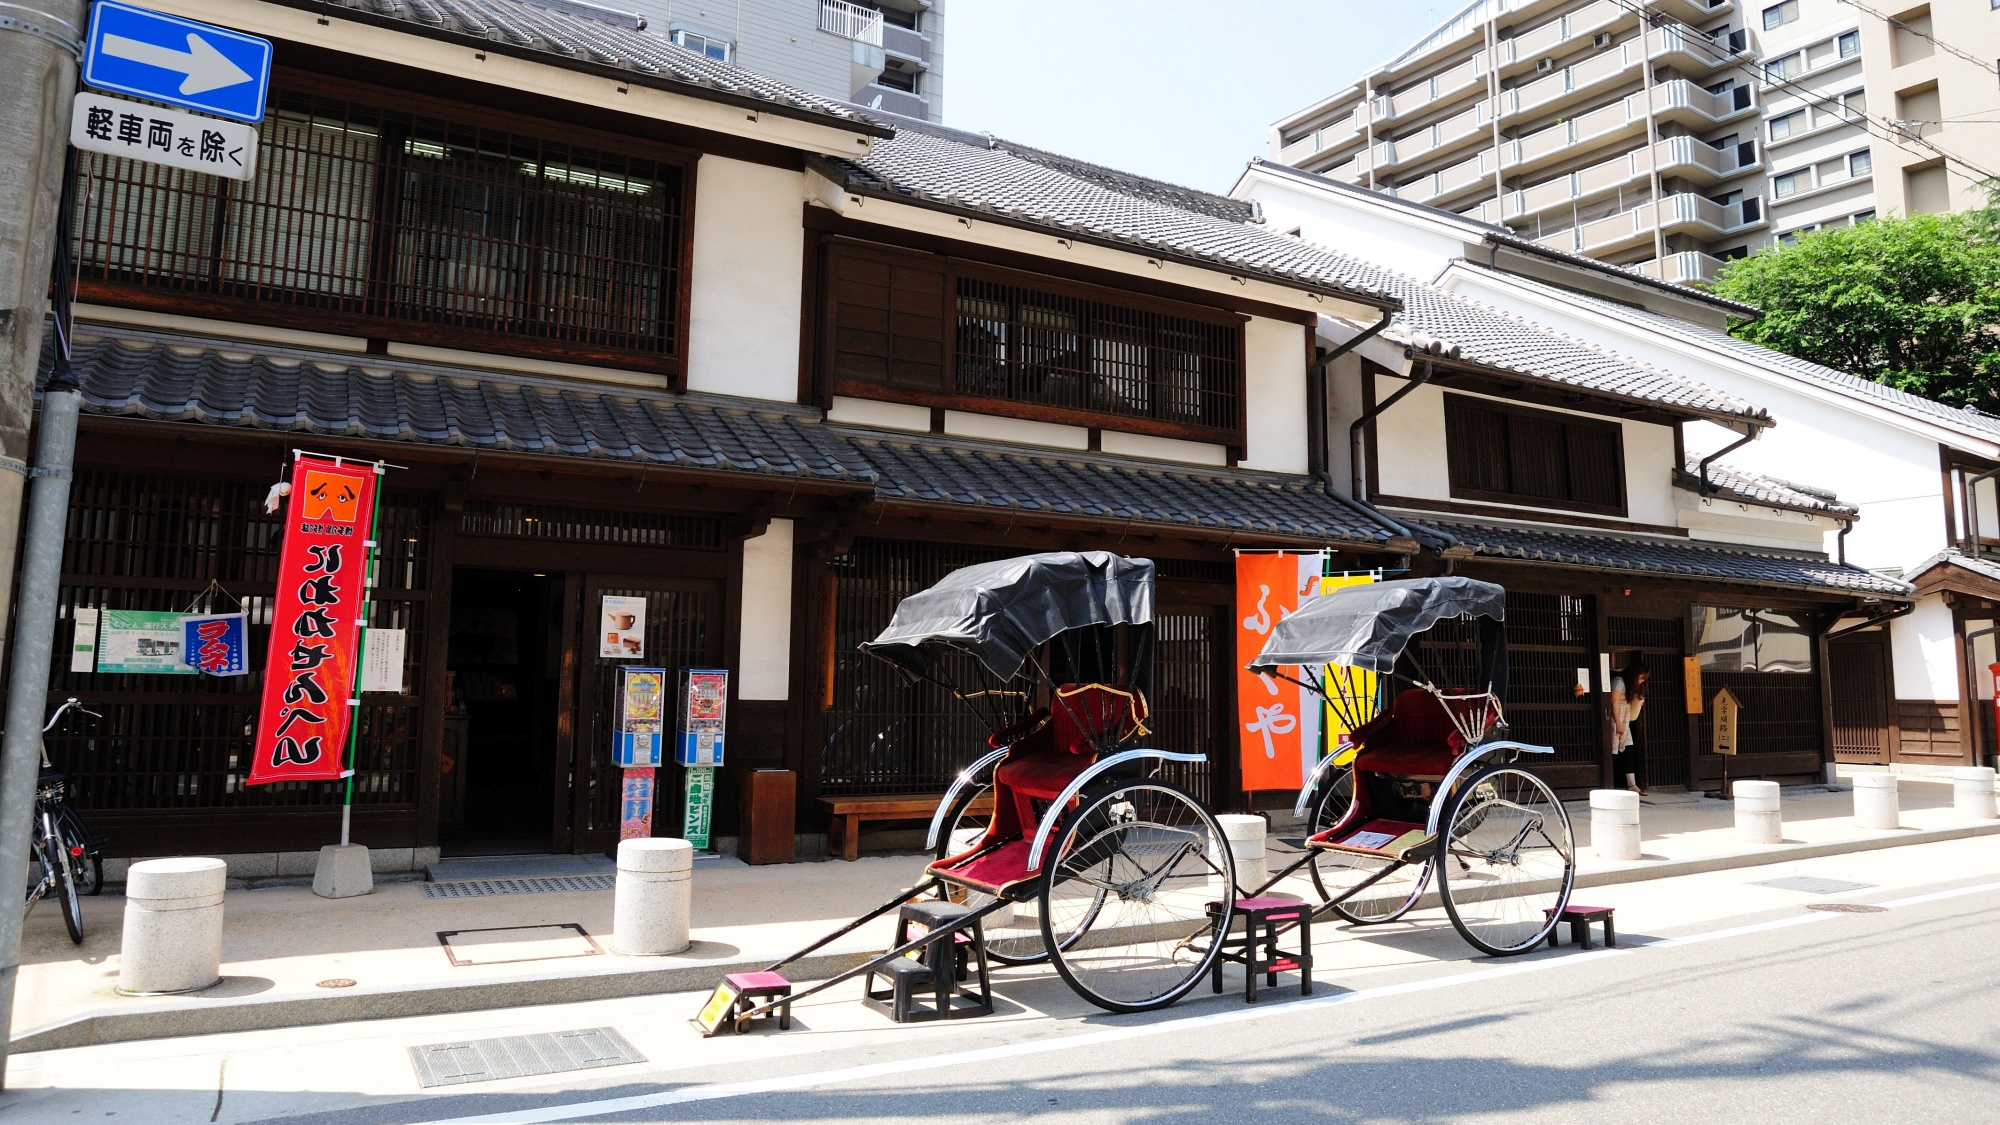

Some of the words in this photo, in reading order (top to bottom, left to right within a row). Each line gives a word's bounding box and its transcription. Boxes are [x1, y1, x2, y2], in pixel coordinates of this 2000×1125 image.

[86, 105, 243, 167] 軽車両を除く
[197, 619, 230, 672] ラムネ
